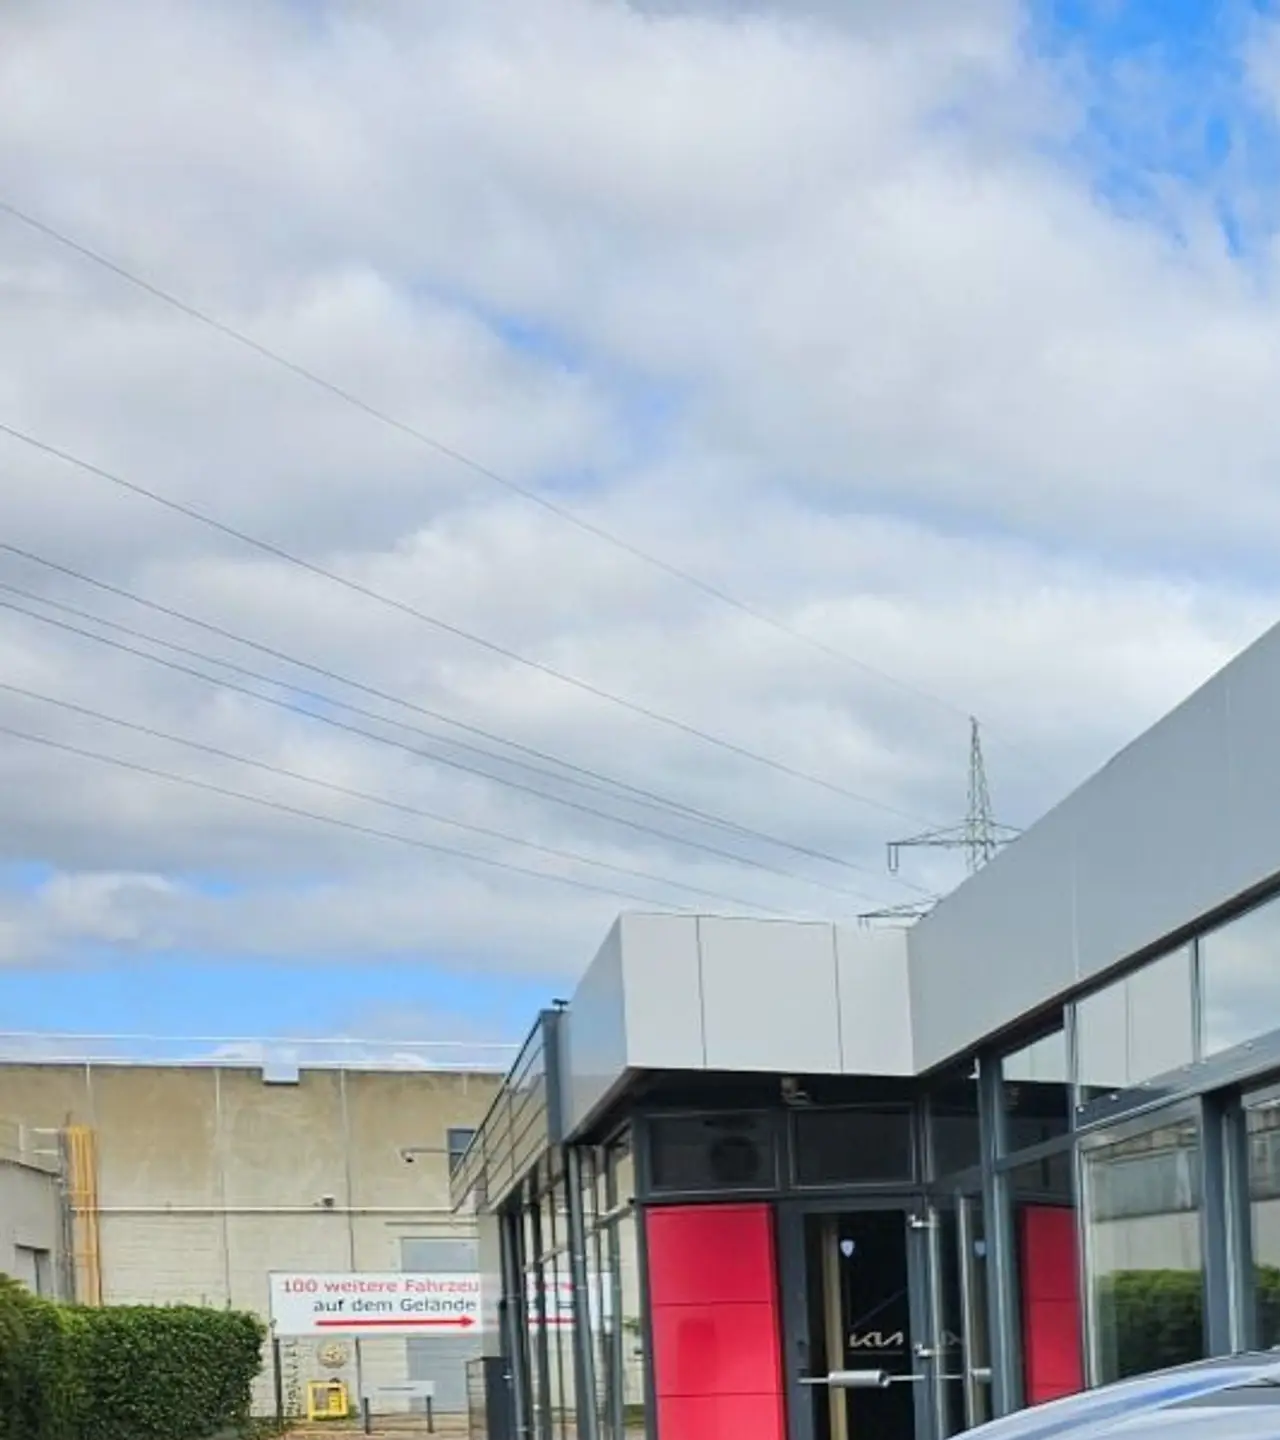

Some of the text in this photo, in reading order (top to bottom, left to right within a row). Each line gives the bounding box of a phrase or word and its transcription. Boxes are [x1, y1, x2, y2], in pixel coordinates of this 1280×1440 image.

[283, 1277, 479, 1293] 100 weitere Fahrzeu
[313, 1298, 344, 1312] auf
[352, 1298, 393, 1312] dem
